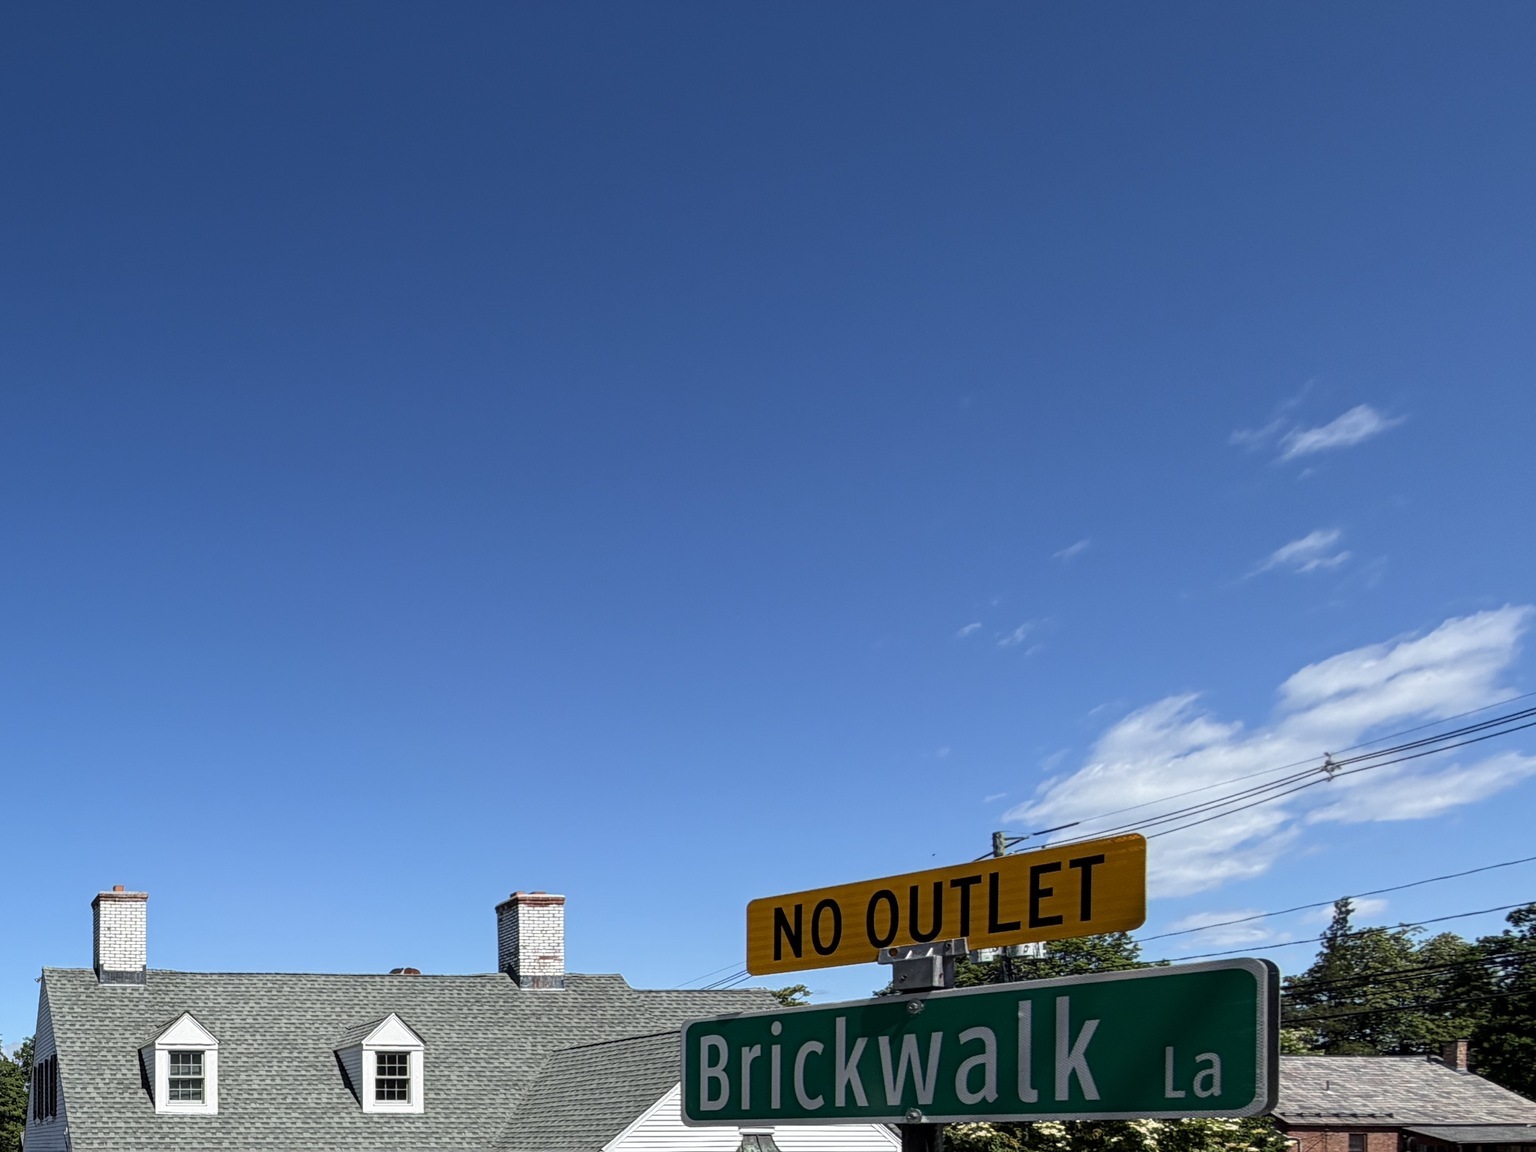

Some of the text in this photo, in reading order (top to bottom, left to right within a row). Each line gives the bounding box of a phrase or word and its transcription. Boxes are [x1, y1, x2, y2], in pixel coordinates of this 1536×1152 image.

[772, 854, 1106, 962] NO OUTLET
[699, 996, 1223, 1112] Brickwalk La
